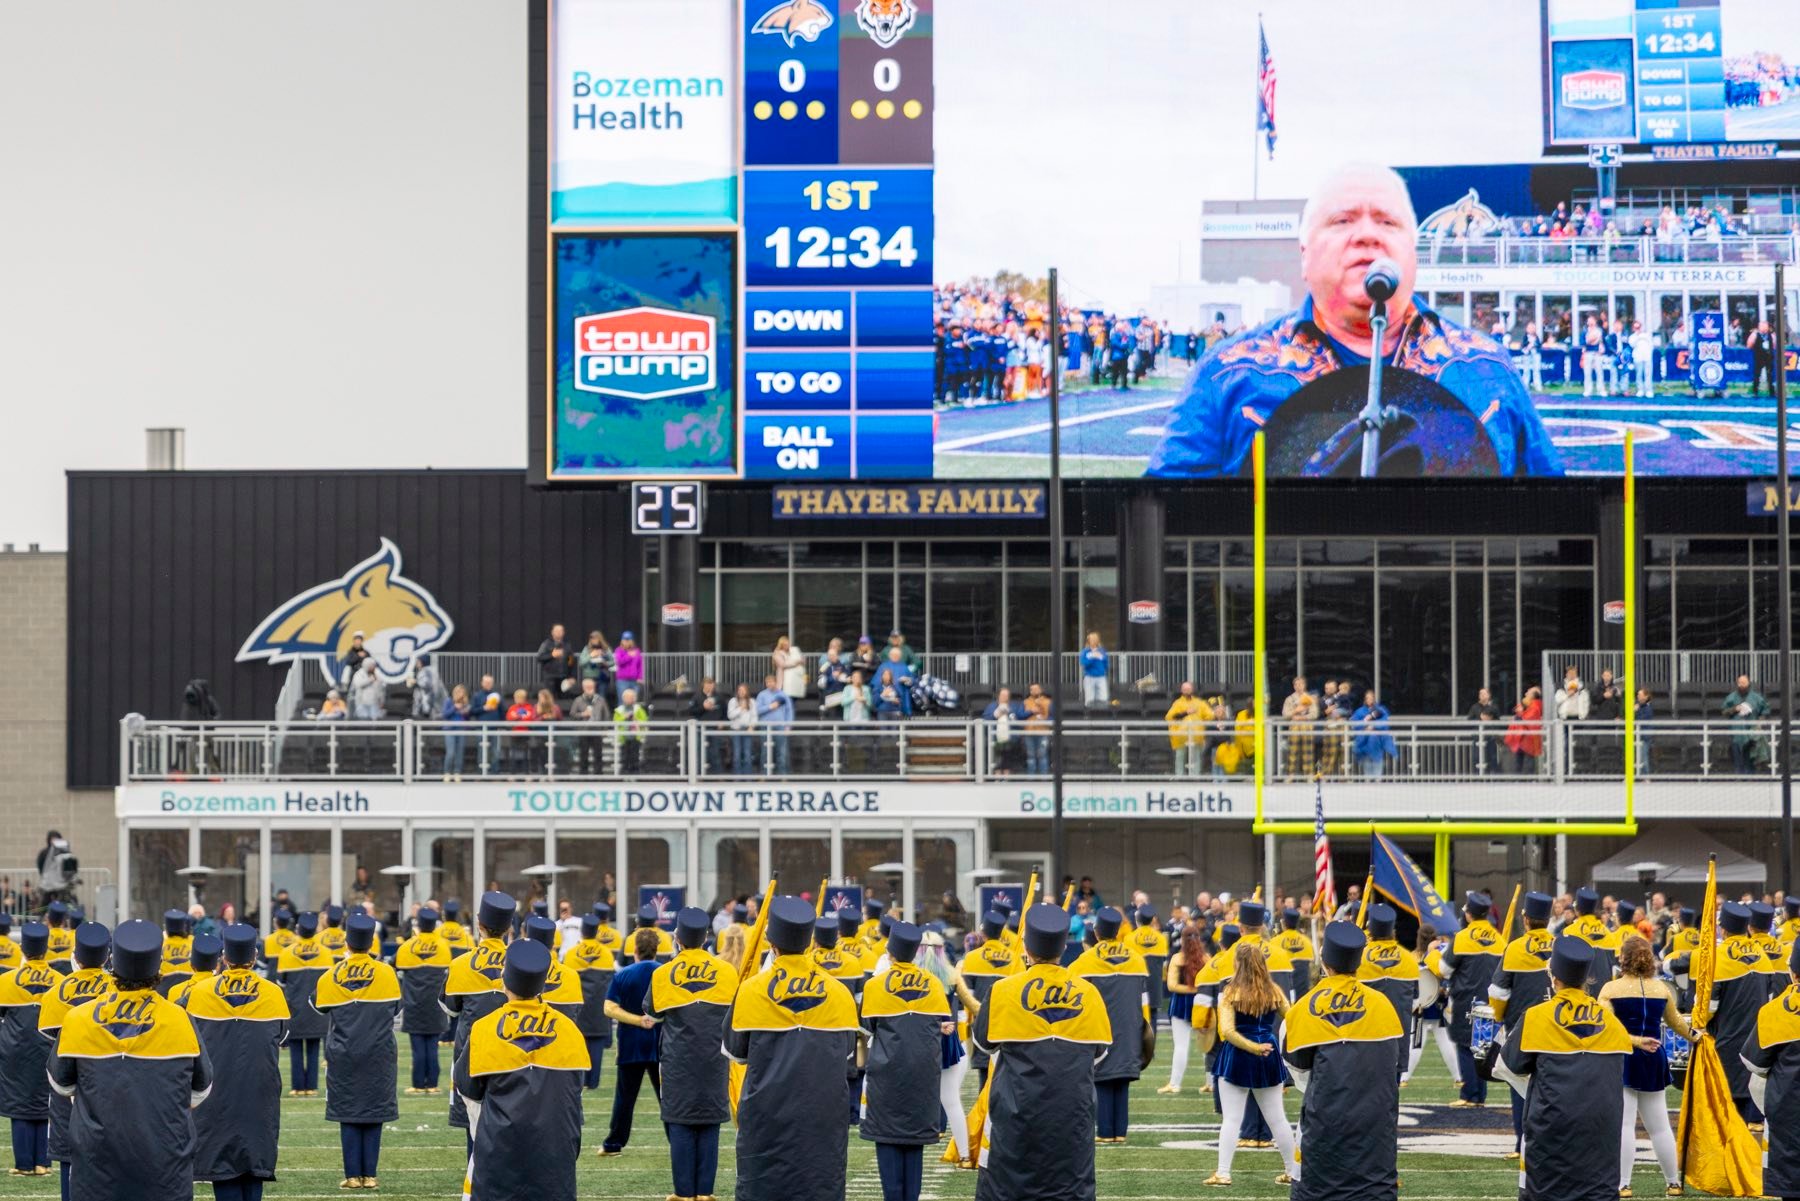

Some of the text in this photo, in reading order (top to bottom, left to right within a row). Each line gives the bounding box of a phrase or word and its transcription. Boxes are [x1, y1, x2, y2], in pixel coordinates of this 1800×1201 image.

[1662, 14, 1696, 28] 1ST
[1645, 32, 1715, 54] 12:34
[572, 71, 724, 98] Bozeman
[779, 59, 806, 92] 0
[873, 59, 900, 92] 0
[573, 102, 683, 130] Health
[1653, 143, 1777, 159] THAYER FAMILY
[803, 181, 878, 210] 1ST
[1255, 221, 1292, 232] Health
[765, 226, 917, 269] 12:34
[1670, 270, 1746, 282] TERRACE
[754, 310, 843, 331] DOWN
[584, 326, 706, 351] town
[587, 355, 706, 380] pump
[756, 372, 842, 393] TO GO
[763, 426, 833, 448] BALL
[776, 448, 819, 470] ON
[637, 486, 698, 529] 25
[776, 488, 1041, 514] THAYER FAMILY
[161, 790, 369, 812] Bozeman Health
[508, 790, 879, 812] TOUCHDOWN TERRACE
[1020, 790, 1232, 812] Boeman Health
[470, 946, 505, 970] Ca
[15, 966, 54, 987] Cats
[333, 960, 374, 985] Cats
[670, 960, 718, 986] Cats
[768, 968, 826, 1002] Cats
[885, 969, 929, 993] Cats
[213, 975, 260, 996] Cats
[1021, 977, 1084, 1011] Cats
[1309, 986, 1364, 1017] Cats
[1554, 1000, 1603, 1027] Cats
[496, 1005, 557, 1040] Cats
